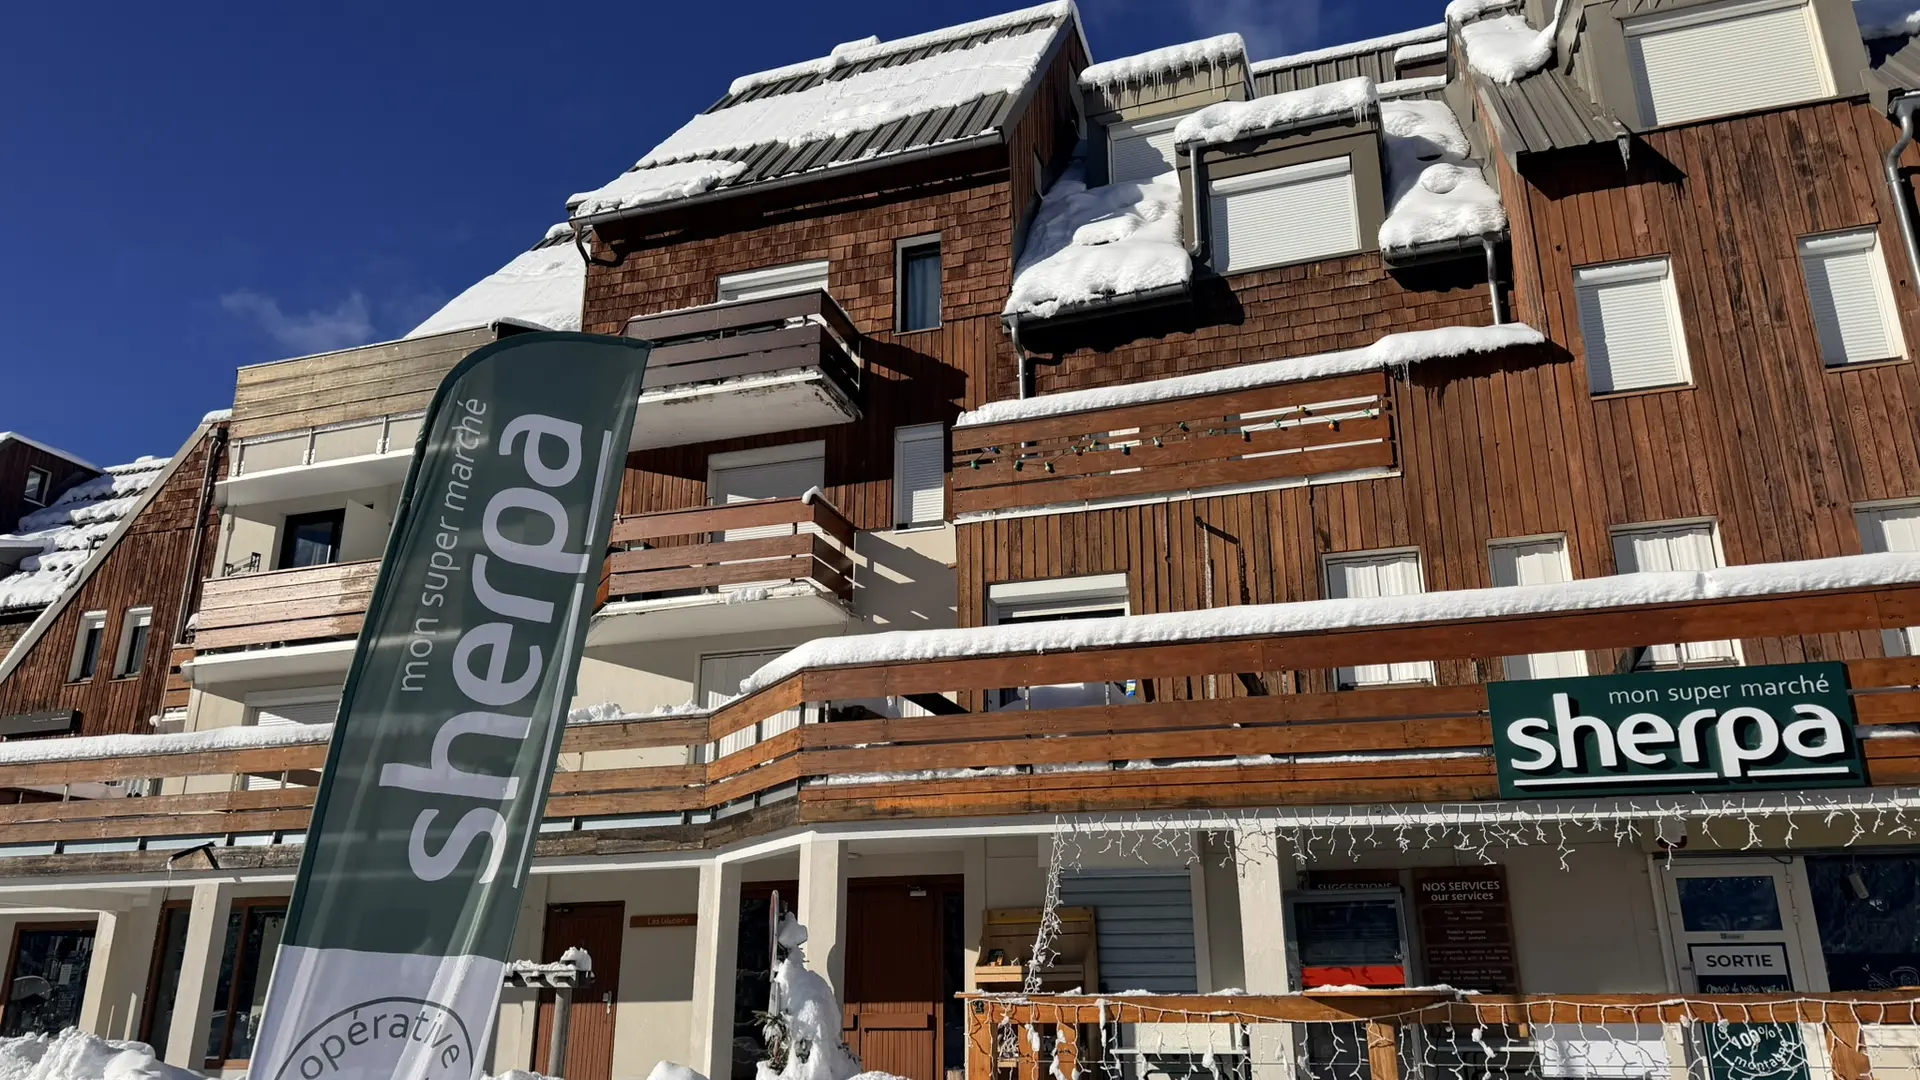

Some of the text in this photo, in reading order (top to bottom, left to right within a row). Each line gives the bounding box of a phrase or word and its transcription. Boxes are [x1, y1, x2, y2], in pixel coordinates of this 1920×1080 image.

[401, 396, 487, 693] mon super marché
[379, 412, 590, 885] sherpa
[1609, 673, 1830, 705] mon super marché
[1507, 692, 1845, 778] sherpa
[1422, 880, 1500, 892] NOS SERVICES
[1431, 891, 1494, 901] our services
[1706, 954, 1773, 967] SORTIE
